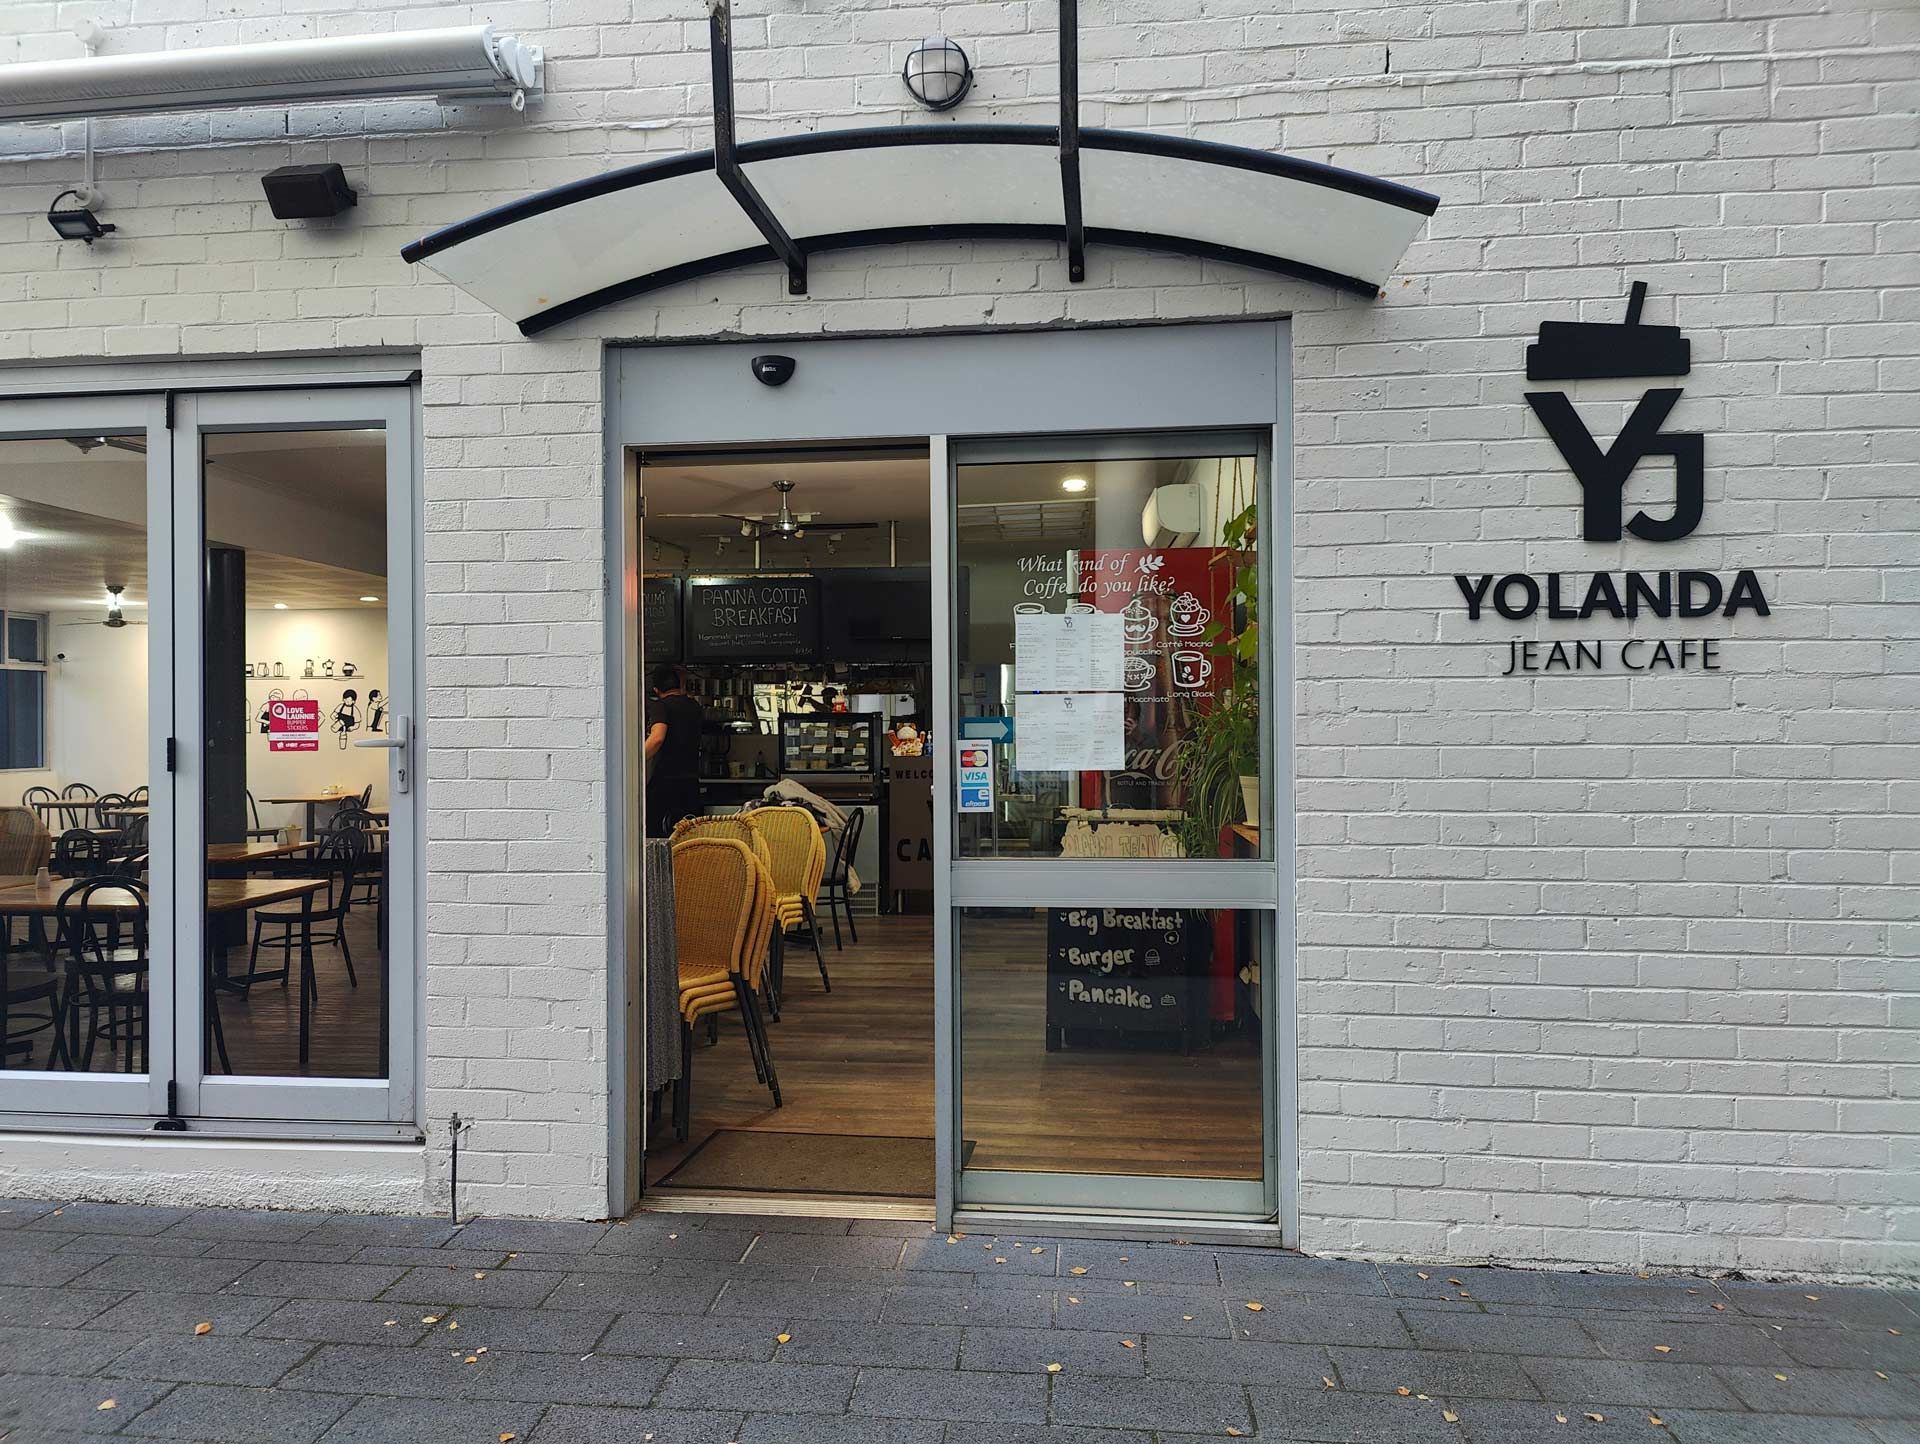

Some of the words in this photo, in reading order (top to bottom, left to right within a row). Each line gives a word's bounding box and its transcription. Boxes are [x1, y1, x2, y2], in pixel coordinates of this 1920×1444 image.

[1524, 388, 1704, 542] YJ
[1017, 554, 1063, 573] What
[1110, 554, 1129, 576] of
[702, 588, 757, 605] PANNA
[761, 588, 808, 605] COTTA
[1079, 576, 1097, 593] do
[1100, 580, 1131, 598] you
[1138, 574, 1175, 595] like?
[1453, 570, 1771, 621] YOLANDA
[712, 606, 799, 627] BREAKFAST
[1185, 640, 1213, 648] Mocha
[1502, 639, 1602, 676] JEAN
[1621, 638, 1721, 670] CAFE
[1167, 691, 1190, 699] Long
[1191, 690, 1215, 698] Black
[965, 771, 988, 781] VISA
[1068, 909, 1098, 936] Big
[1103, 908, 1183, 931] Breakfast
[1068, 948, 1135, 973] Burger
[1069, 979, 1152, 1010] Pancake
